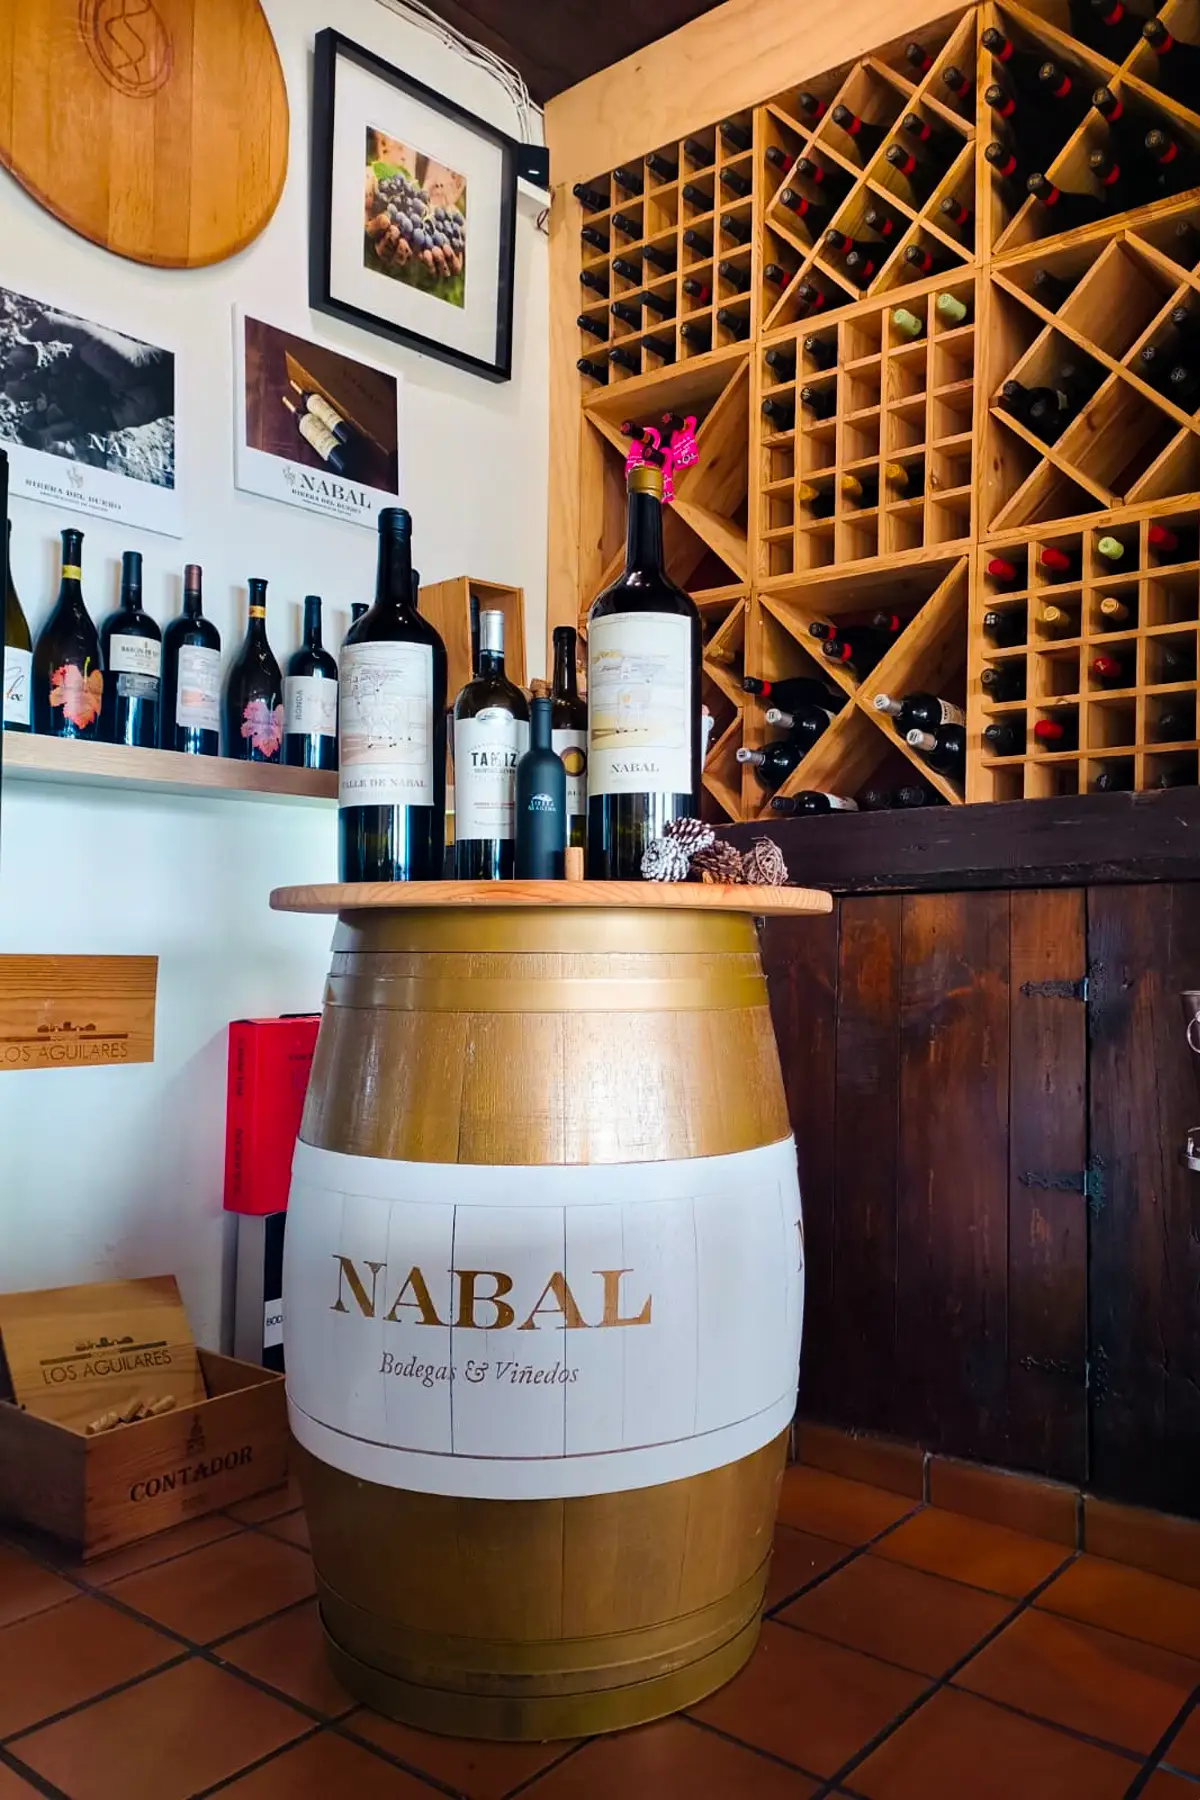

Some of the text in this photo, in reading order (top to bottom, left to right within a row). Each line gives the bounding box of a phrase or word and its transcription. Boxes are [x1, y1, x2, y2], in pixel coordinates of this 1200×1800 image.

[300, 472, 371, 509] NABAL
[369, 778, 386, 788] DE
[391, 779, 428, 789] NABAL
[610, 763, 660, 774] NABAL
[0, 1042, 128, 1063] OS AGUILARES
[330, 1254, 652, 1331] NABAL
[42, 1350, 172, 1385] LOS AGUILARES
[379, 1351, 579, 1388] Bodegas & Viñedos
[130, 1446, 253, 1501] CONTADOR
